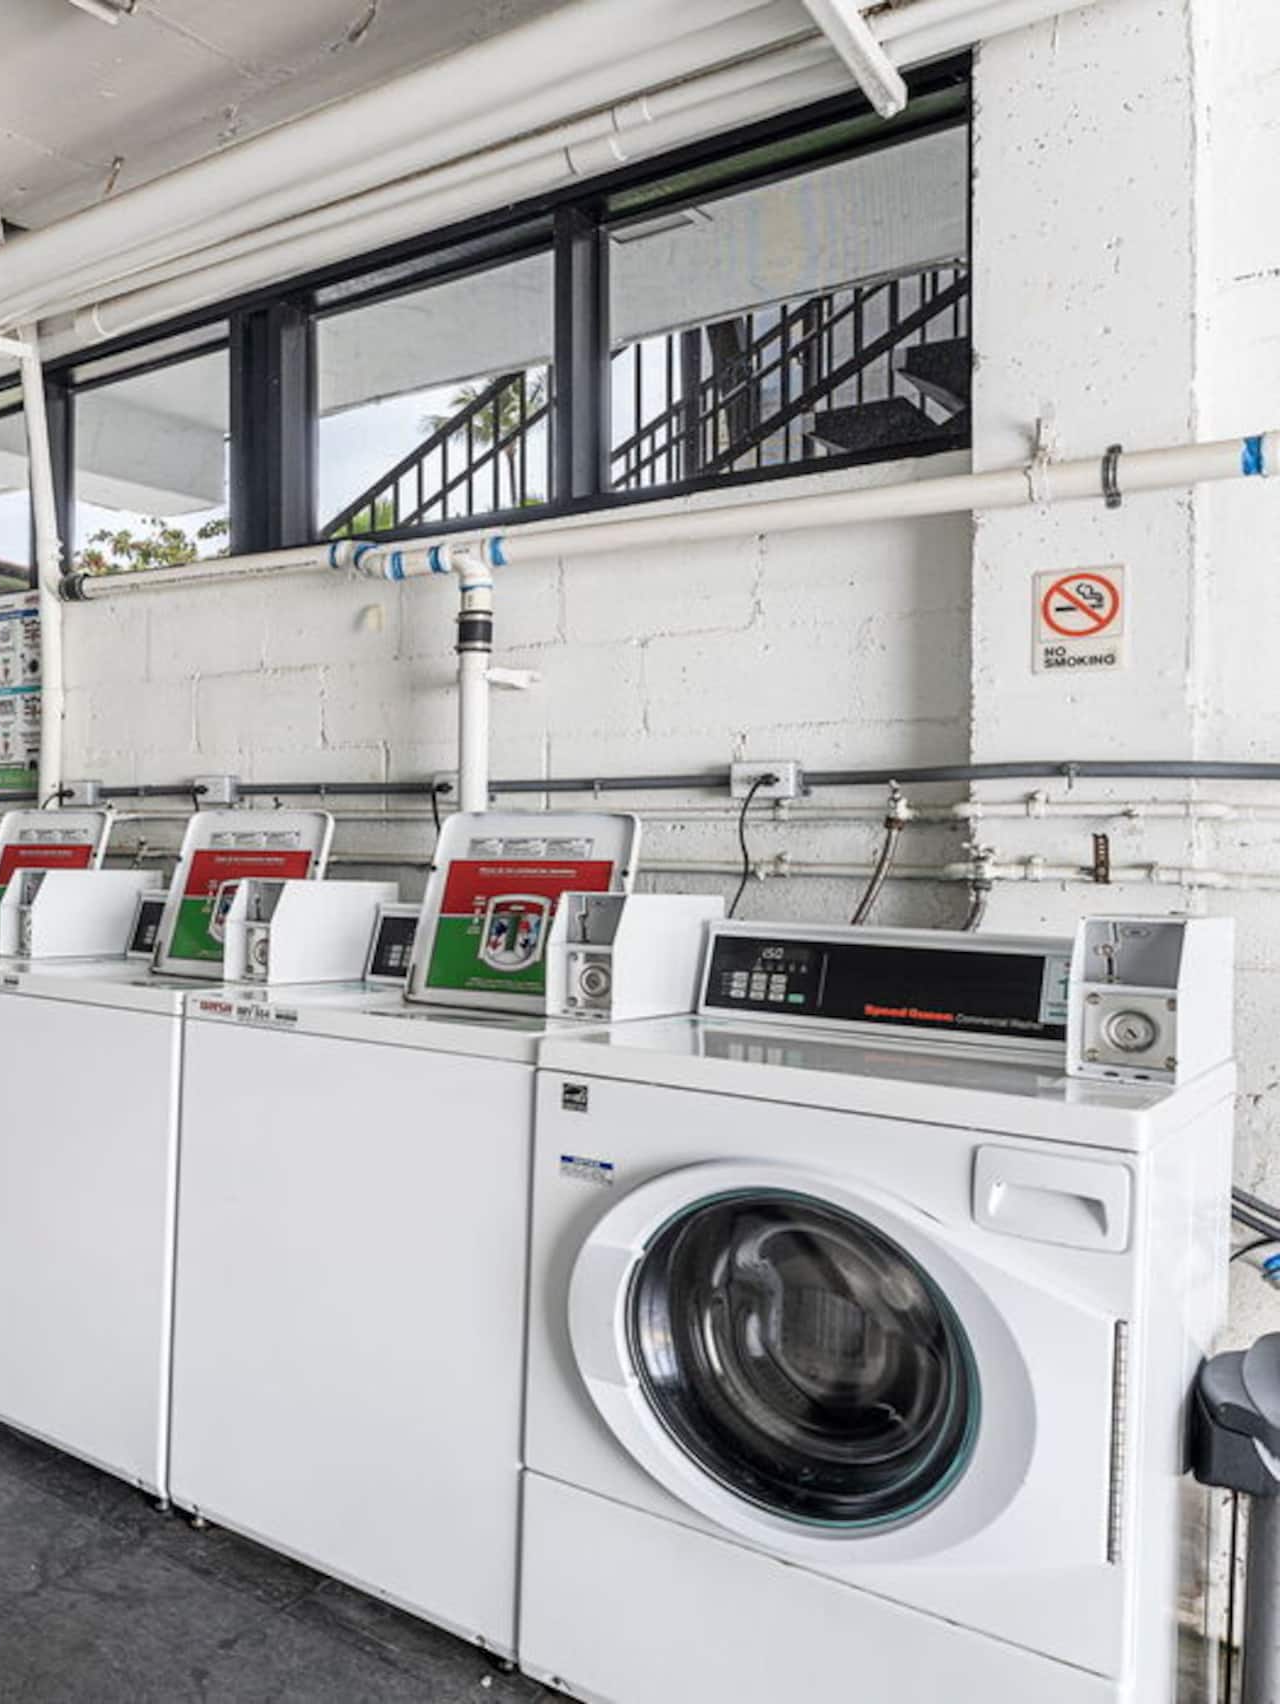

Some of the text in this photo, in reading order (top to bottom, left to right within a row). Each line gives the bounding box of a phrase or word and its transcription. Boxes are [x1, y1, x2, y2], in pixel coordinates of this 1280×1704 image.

[1043, 646, 1066, 656] NO
[1043, 654, 1115, 668] SMOKING
[863, 1003, 907, 1018] Speed
[909, 1008, 954, 1022] Queen
